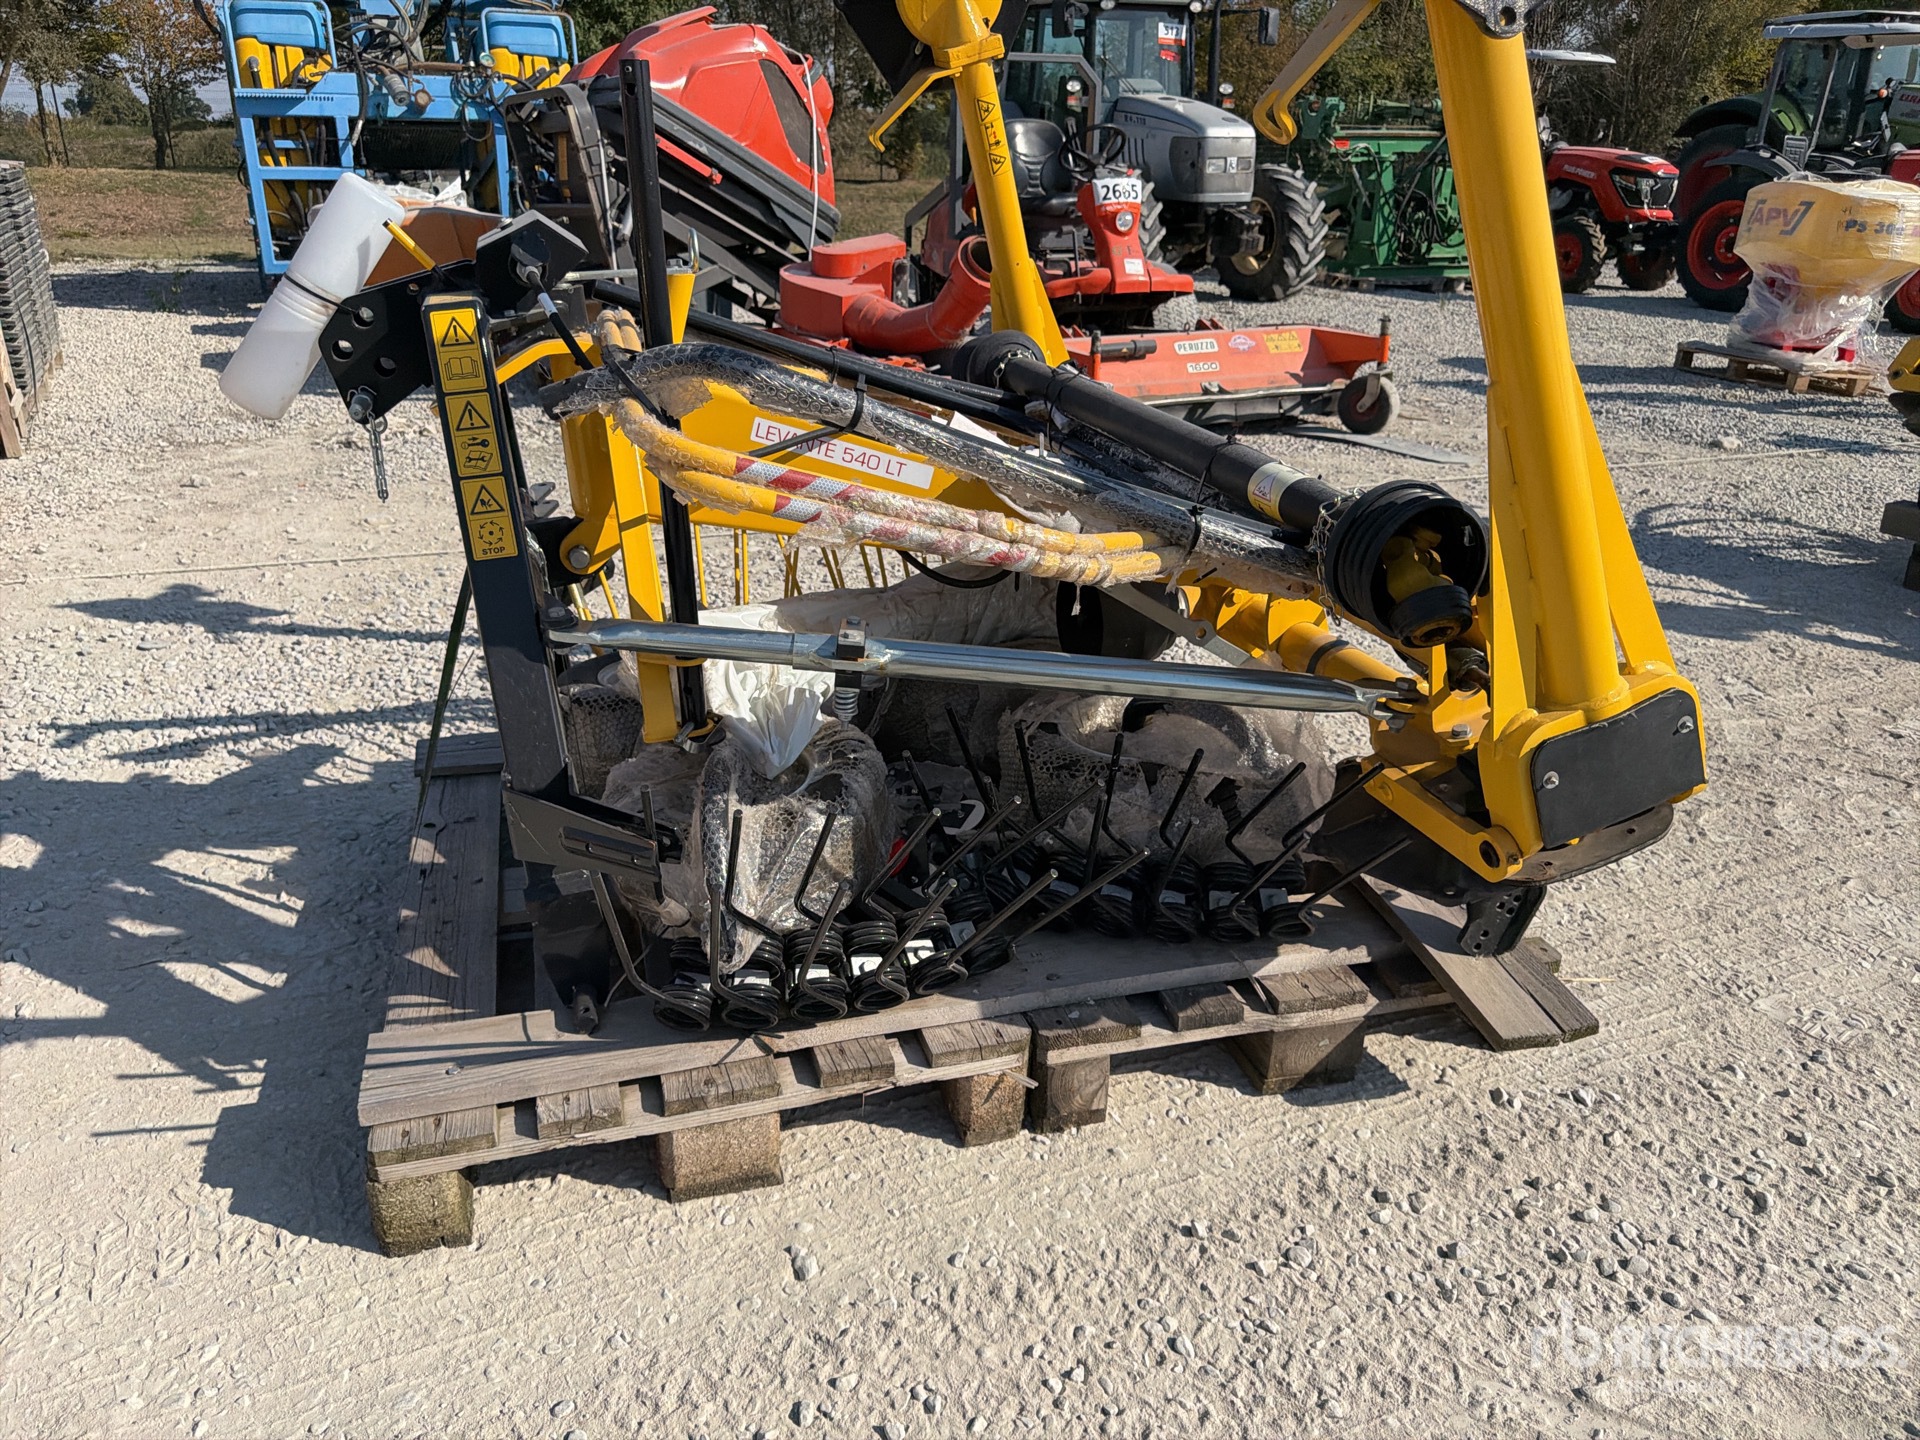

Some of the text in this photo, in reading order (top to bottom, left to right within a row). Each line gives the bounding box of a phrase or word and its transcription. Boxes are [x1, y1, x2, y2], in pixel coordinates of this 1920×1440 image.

[1101, 183, 1139, 200] 2665
[1177, 341, 1216, 352] PERUZZO
[1189, 362, 1218, 372] 1600
[841, 449, 881, 471] 540
[885, 460, 907, 478] LT
[481, 546, 506, 556] STOP
